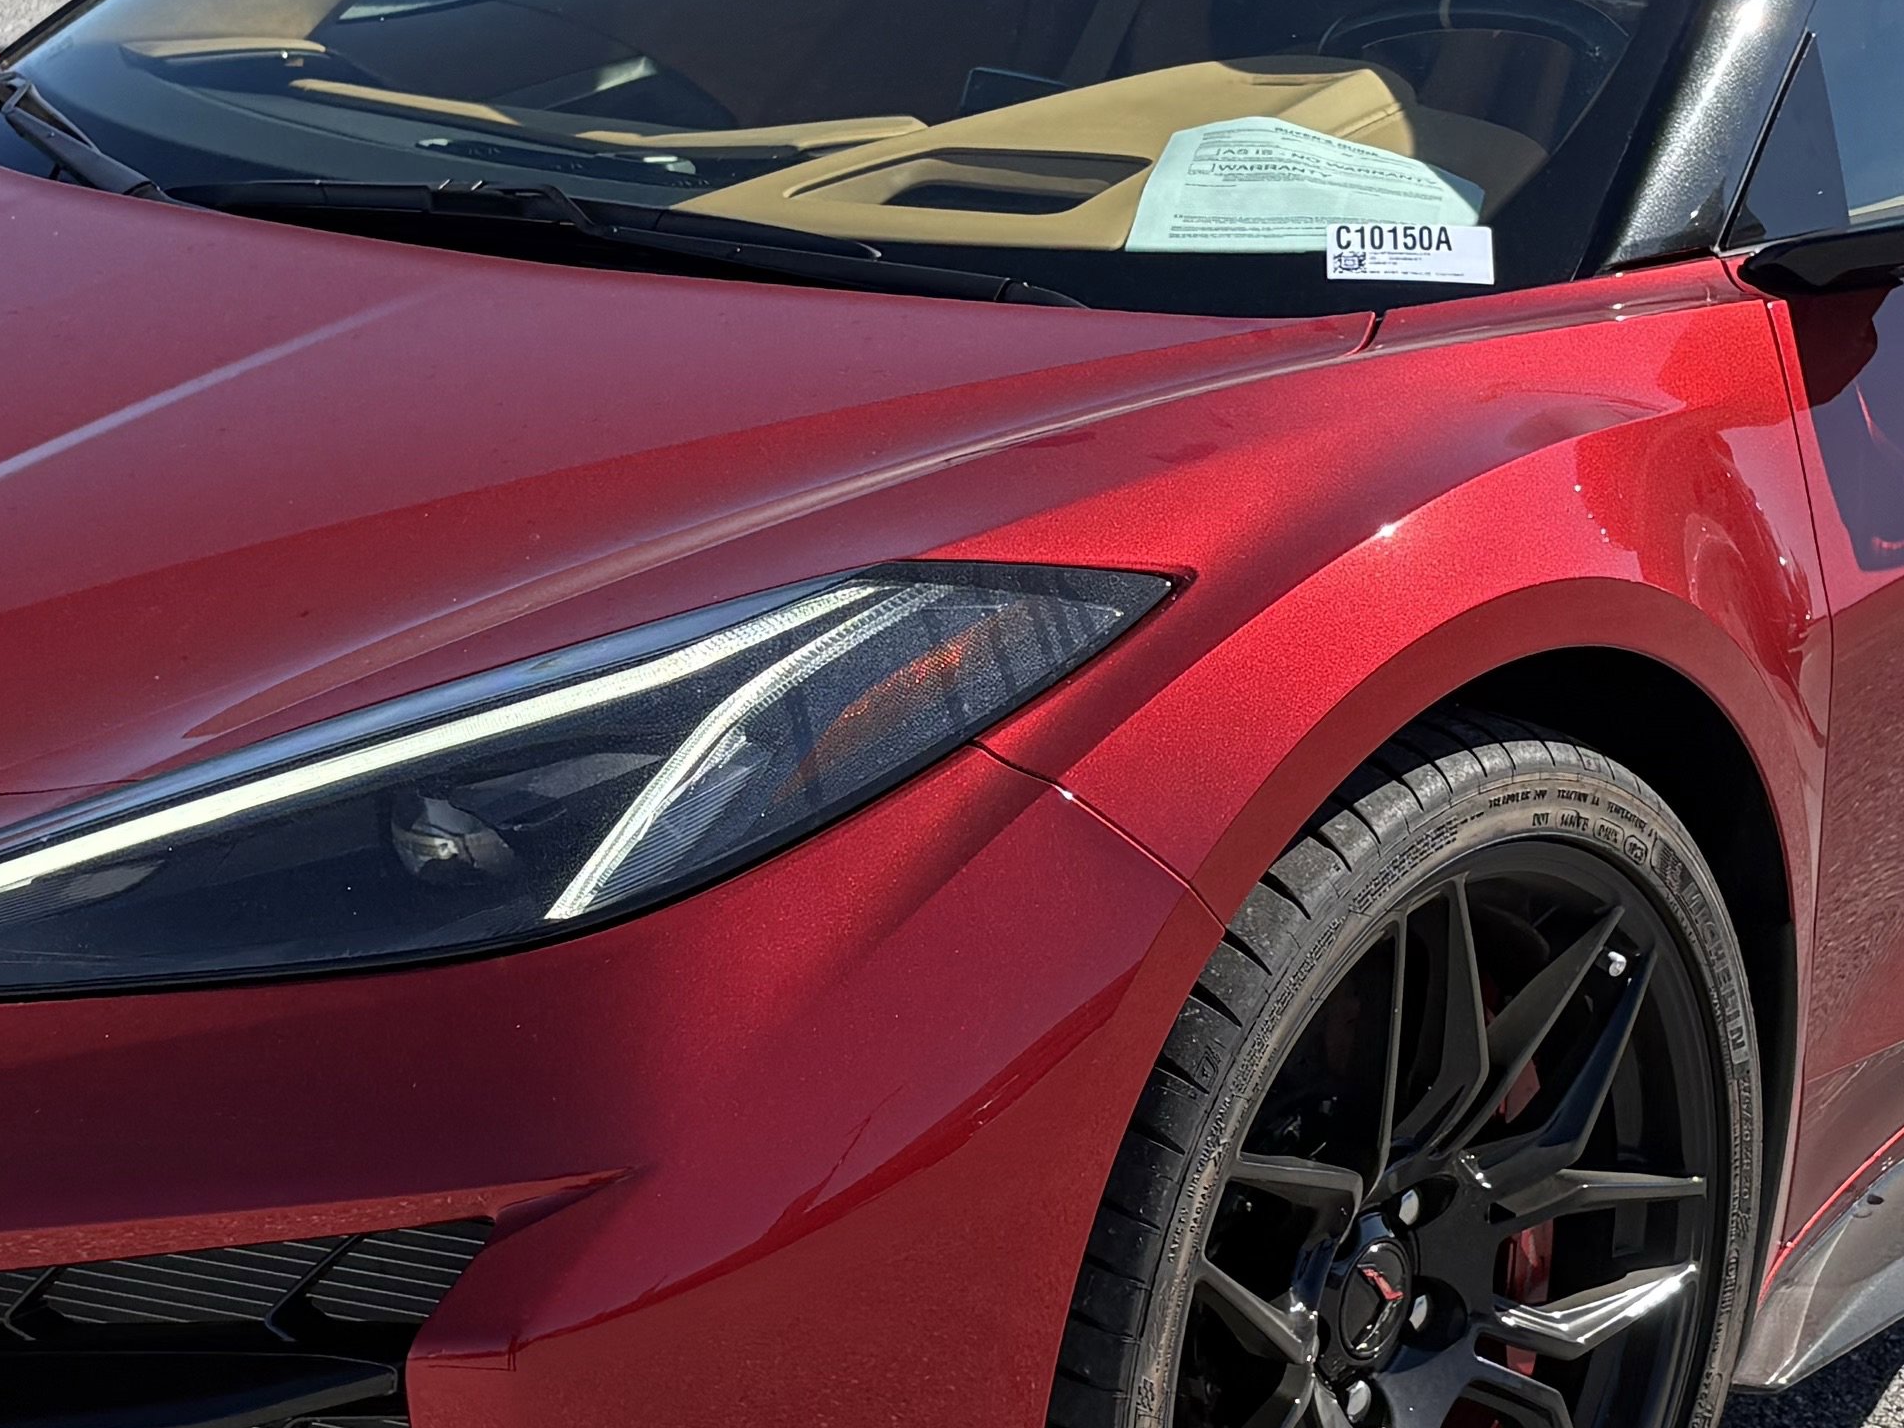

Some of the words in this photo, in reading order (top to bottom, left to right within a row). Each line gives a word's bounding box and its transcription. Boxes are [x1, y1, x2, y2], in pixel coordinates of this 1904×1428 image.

[1218, 163, 1333, 178] WARRANTY
[1325, 161, 1437, 185] WARRANTY
[1336, 225, 1452, 251] C10150A
[1681, 880, 1747, 1055] MICHELIN
